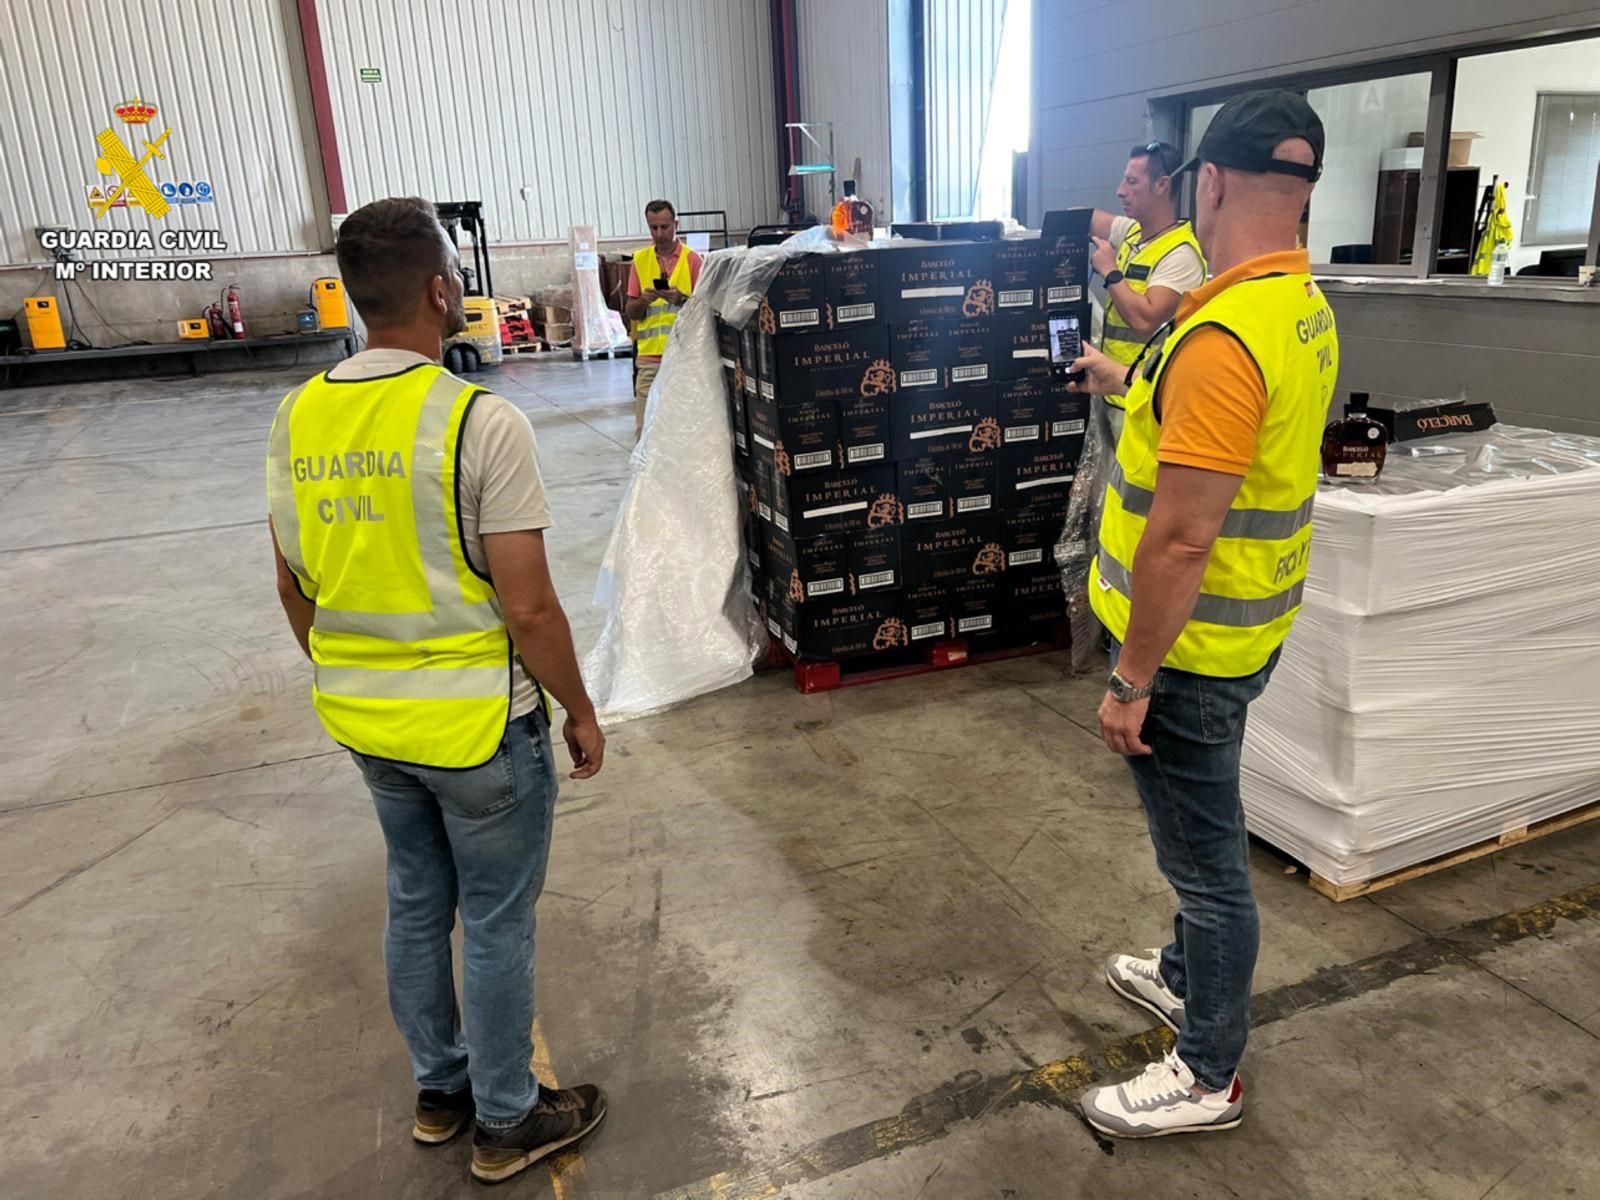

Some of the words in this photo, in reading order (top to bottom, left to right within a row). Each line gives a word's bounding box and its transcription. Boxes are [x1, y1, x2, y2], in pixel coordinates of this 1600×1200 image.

[901, 269, 975, 282] IMPERIAL
[1013, 334, 1047, 345] IMPE
[794, 351, 871, 366] IMPERIAL
[911, 408, 980, 424] IMPERIAL
[1416, 413, 1474, 432] BARCELÓ
[293, 450, 406, 483] GUARDIA
[805, 485, 877, 503] IMPERIAL
[318, 495, 385, 525] CIVIL
[917, 535, 983, 552] IMPERIAL
[814, 610, 883, 629] IMPERIAL
